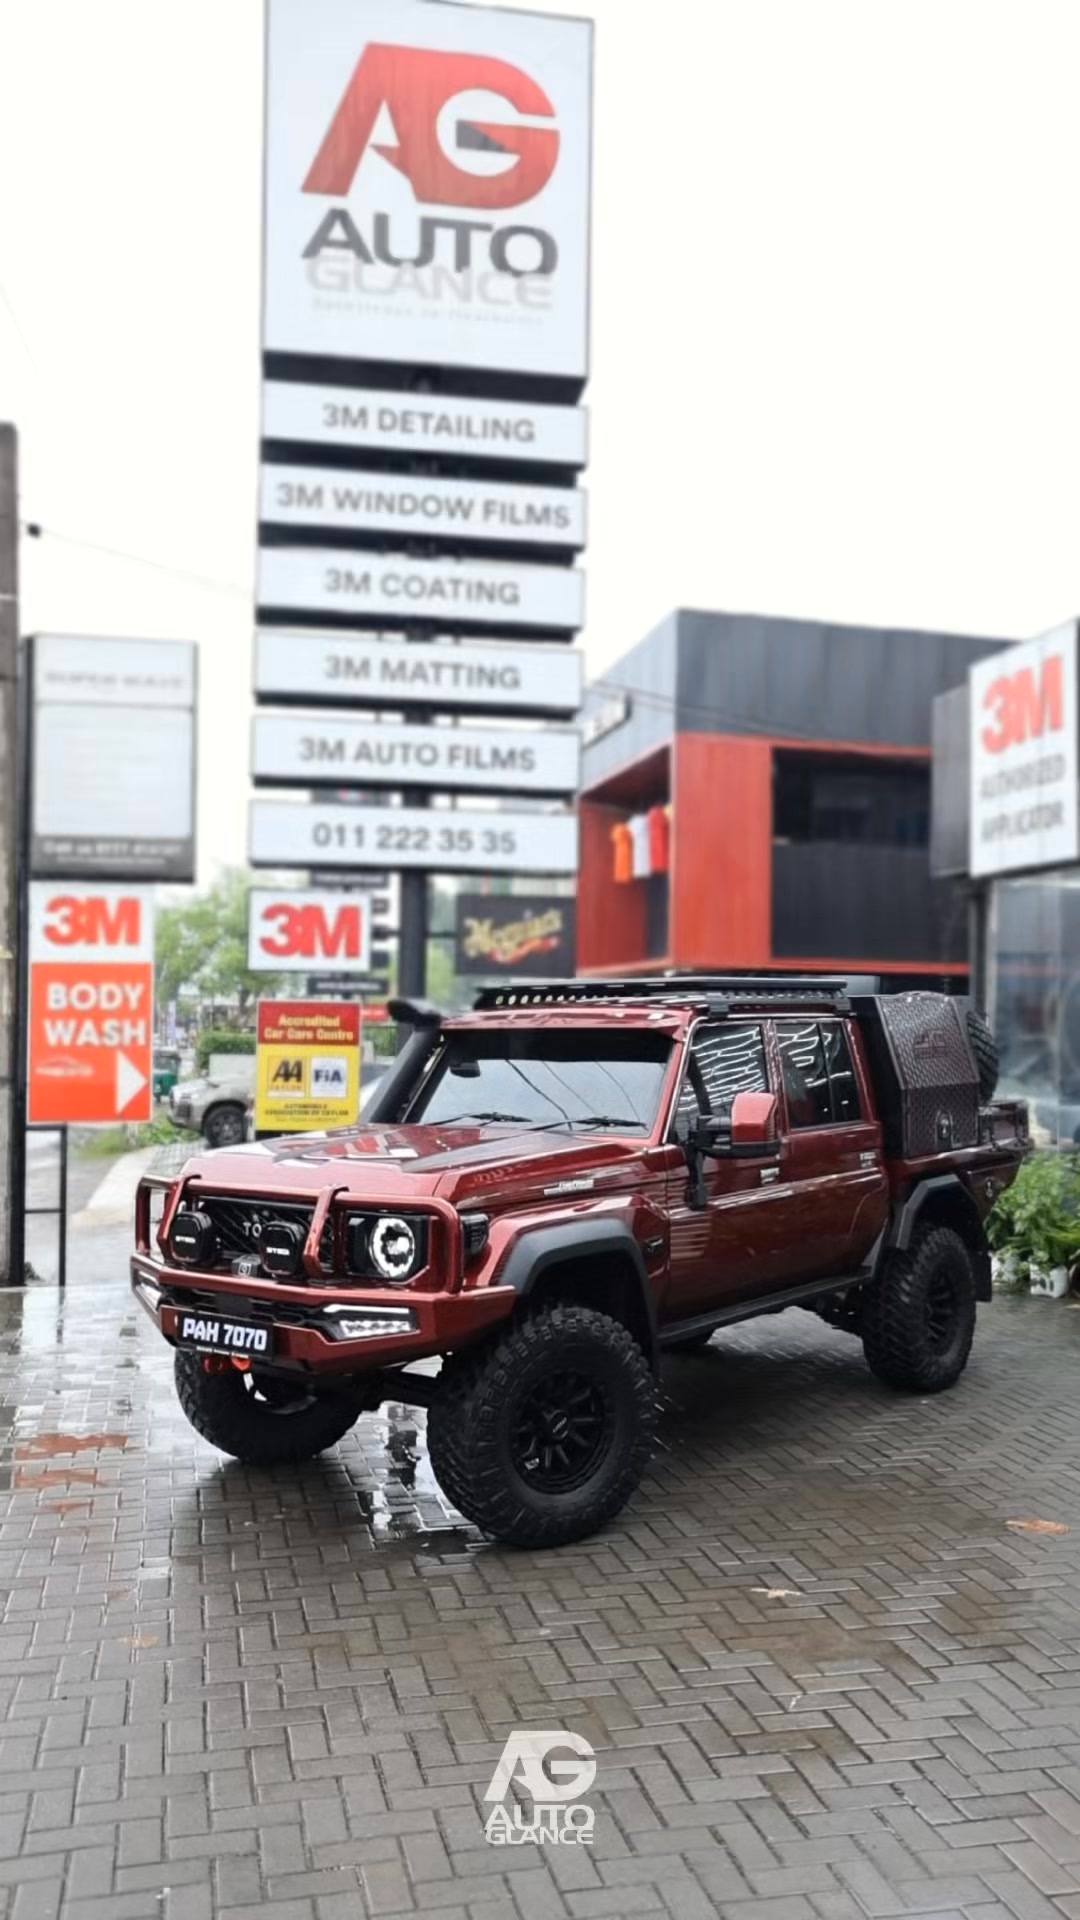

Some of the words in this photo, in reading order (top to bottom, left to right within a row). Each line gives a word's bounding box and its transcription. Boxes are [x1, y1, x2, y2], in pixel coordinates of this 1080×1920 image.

[300, 42, 560, 210] AG
[301, 207, 558, 279] AUTO
[304, 250, 554, 310] GLANCE
[322, 403, 368, 430] 3M
[377, 408, 536, 443] DETAILING
[276, 482, 323, 509] 3M
[332, 487, 474, 521] WINDOW
[482, 499, 571, 529] FILMS
[325, 568, 371, 595] 3M
[380, 572, 521, 605] COATING
[325, 655, 371, 680] 3M
[380, 658, 521, 690] MATTING
[981, 653, 1064, 755] 3M
[299, 736, 345, 762] 3M
[354, 741, 440, 767] AUTO
[448, 744, 536, 772] FILMS
[312, 822, 365, 848] 011
[376, 825, 430, 852] 222
[439, 828, 473, 853] 35
[481, 830, 517, 854] 35
[44, 896, 141, 946] 3M
[260, 903, 362, 959] 3M
[47, 982, 145, 1012] BODY
[44, 1020, 146, 1048] WASH
[264, 1027, 284, 1039] Car
[287, 1028, 314, 1040] Care
[317, 1028, 353, 1041] Centre
[279, 1014, 341, 1027] Accredited
[272, 1059, 303, 1083] AA
[182, 1317, 219, 1342] PAH
[223, 1323, 267, 1350] 7070
